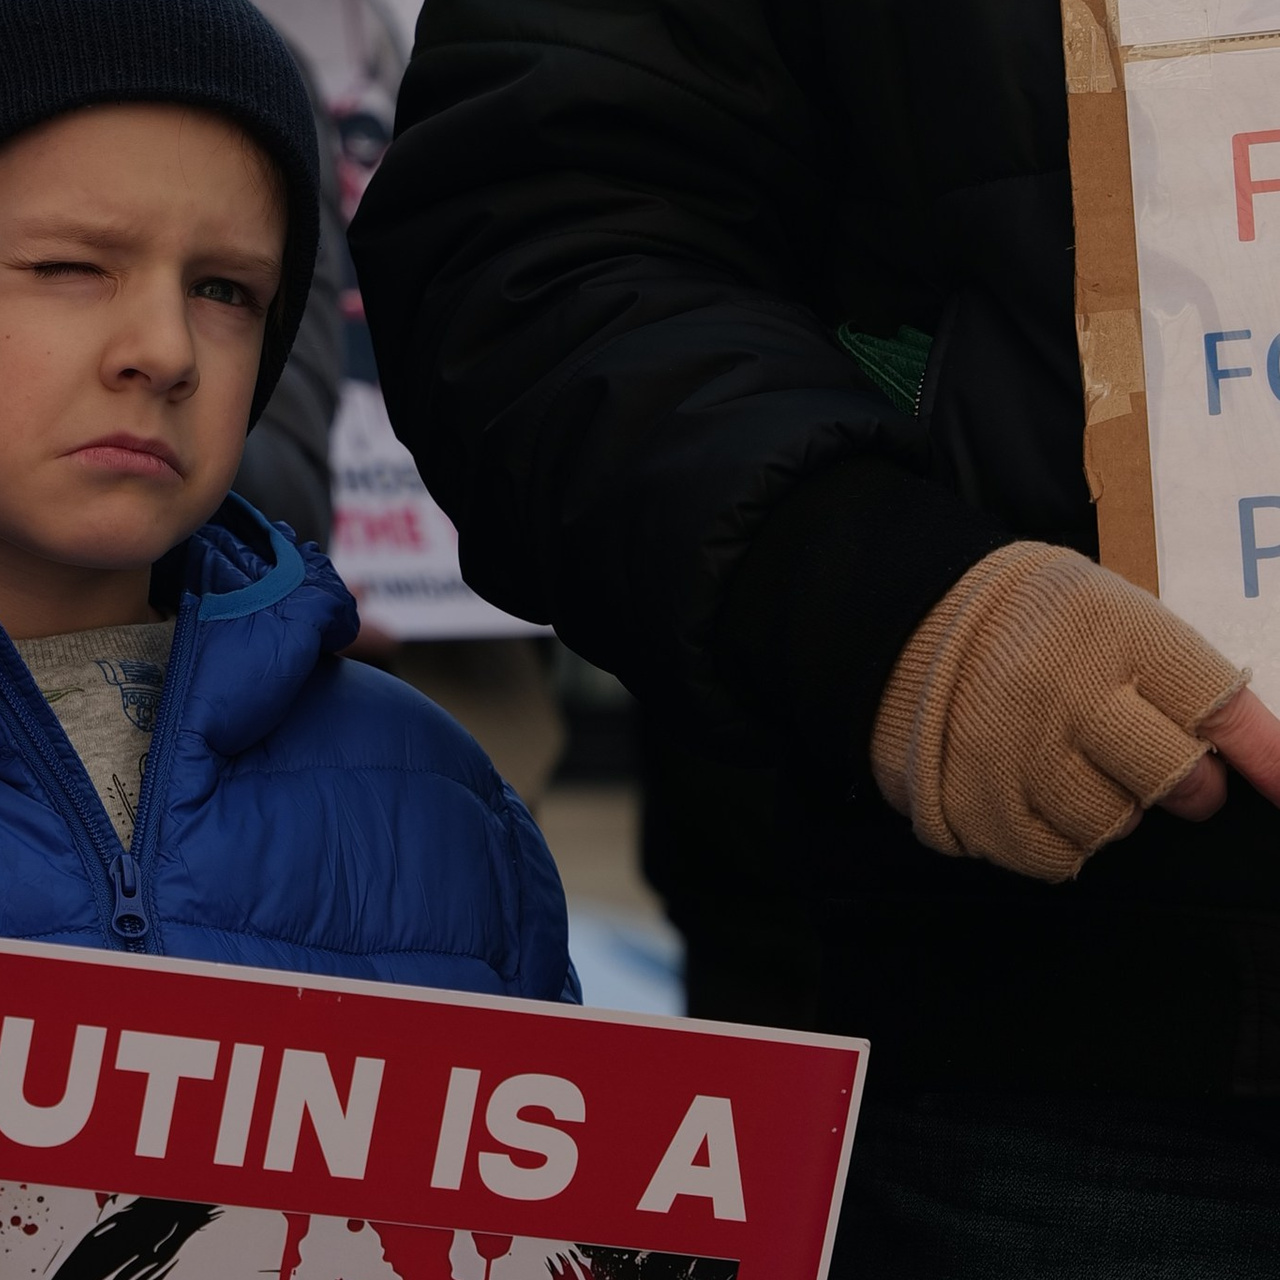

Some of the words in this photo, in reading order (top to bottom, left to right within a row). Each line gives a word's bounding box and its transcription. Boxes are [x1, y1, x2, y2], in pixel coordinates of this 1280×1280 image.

[1204, 329, 1280, 416] F
[429, 1066, 587, 1202] IS
[634, 1094, 749, 1223] A
